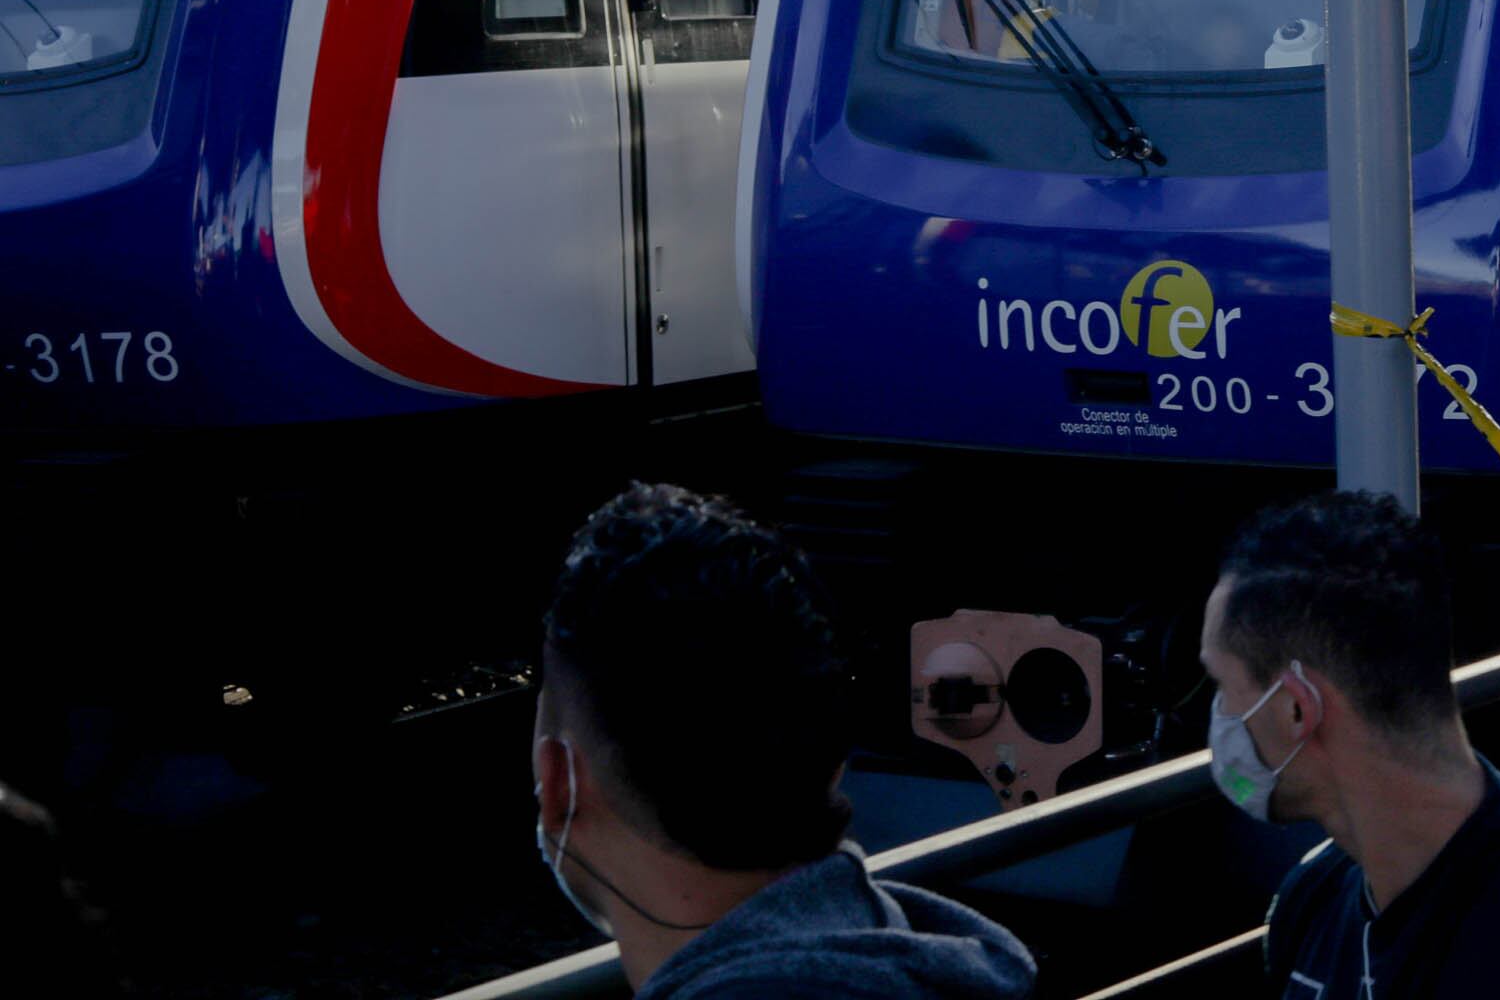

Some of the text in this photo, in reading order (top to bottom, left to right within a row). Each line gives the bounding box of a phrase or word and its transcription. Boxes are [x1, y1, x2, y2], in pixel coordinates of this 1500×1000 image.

[977, 264, 1242, 360] incofer
[1081, 407, 1150, 423] Conector de
[1116, 425, 1131, 436] en
